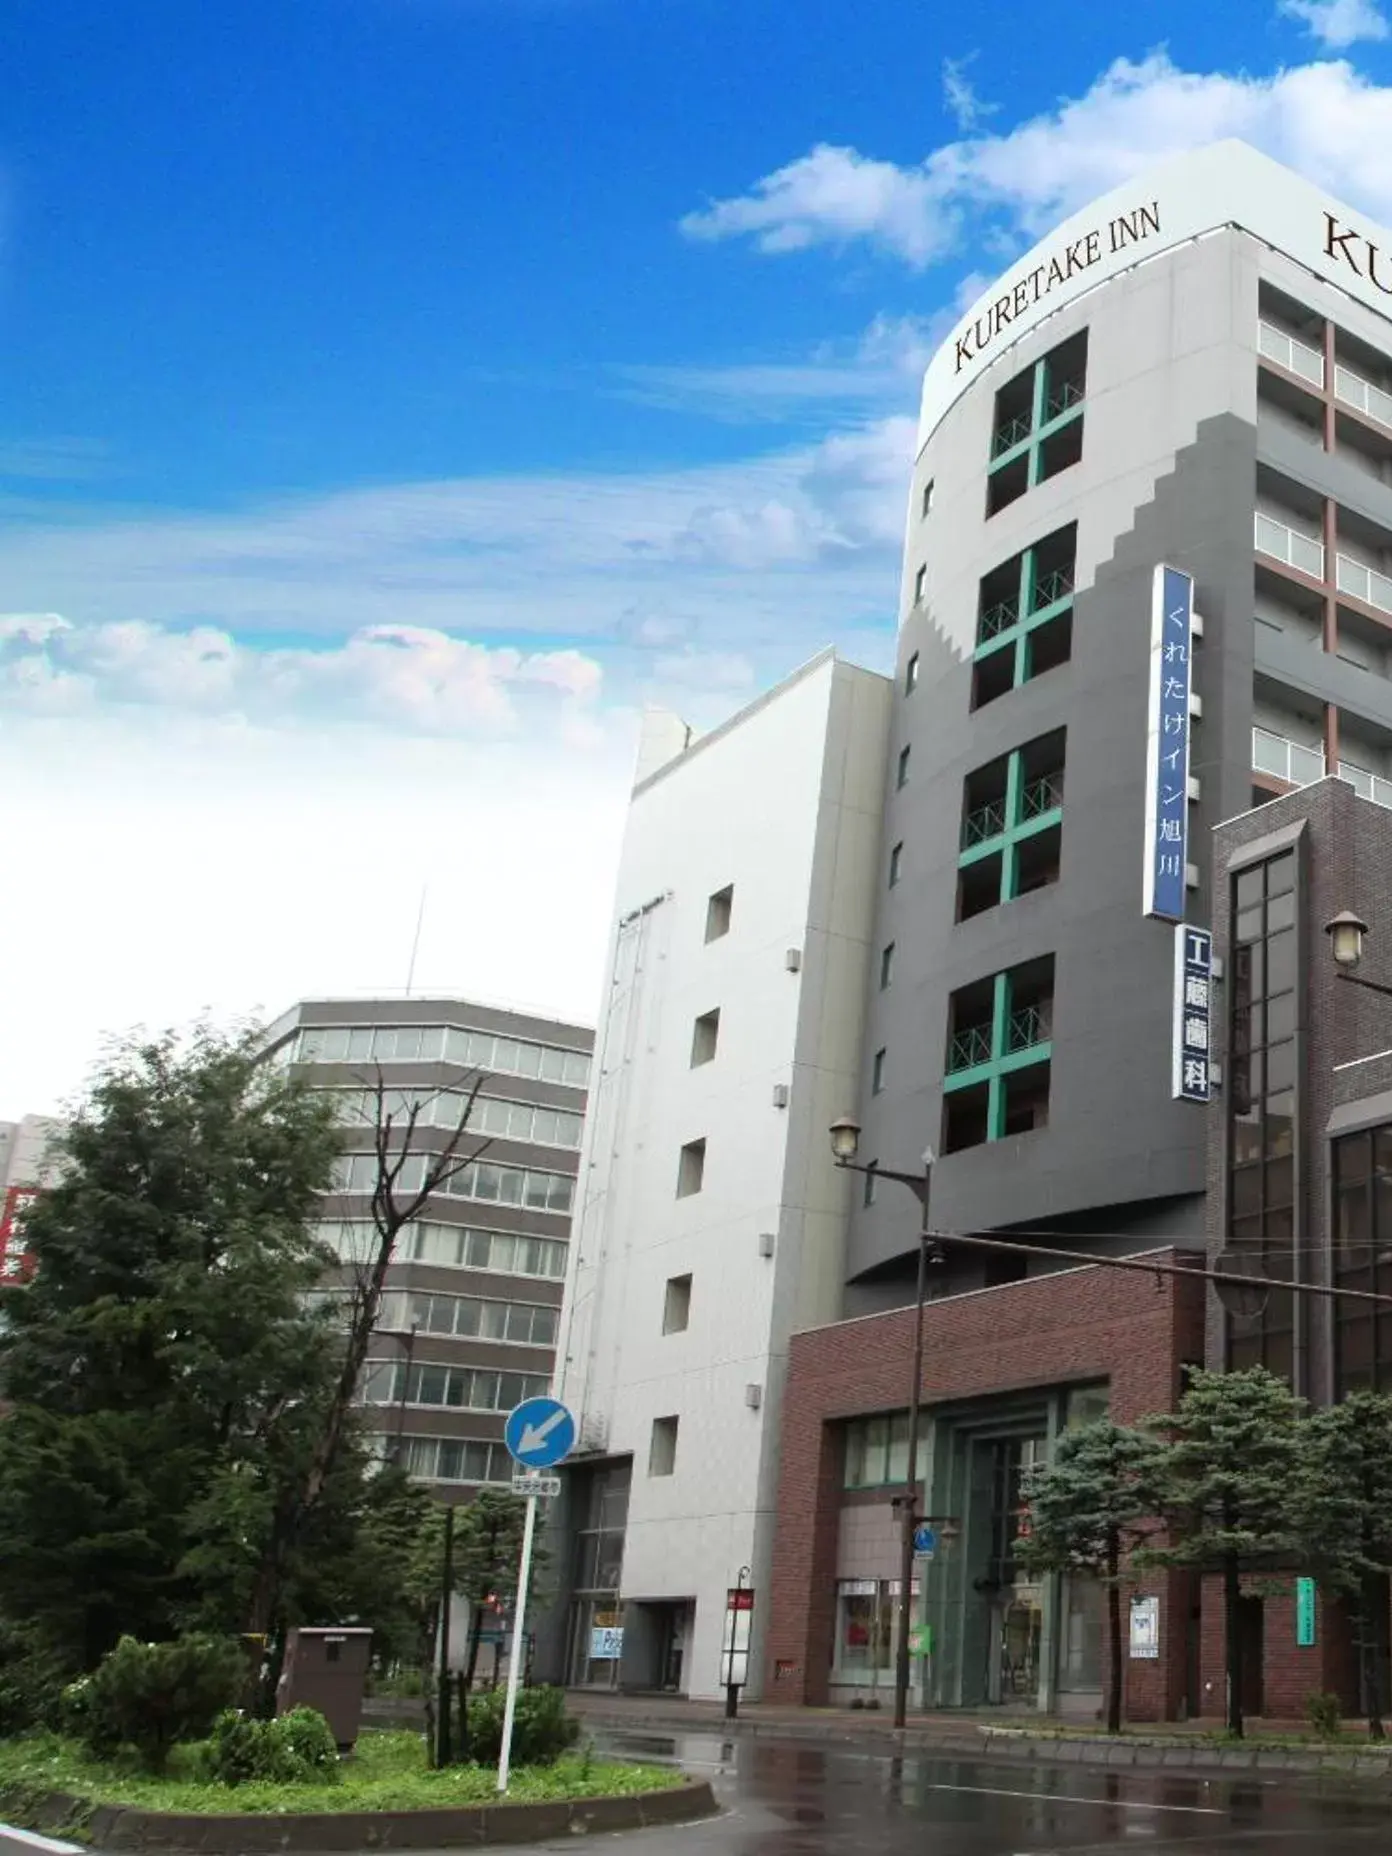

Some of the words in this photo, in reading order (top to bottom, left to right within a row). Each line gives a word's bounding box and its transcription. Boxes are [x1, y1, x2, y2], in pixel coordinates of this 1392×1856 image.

[955, 231, 1101, 374] KURETAKE
[1108, 202, 1160, 253] INN
[1159, 607, 1187, 876] くれたけイン旭川
